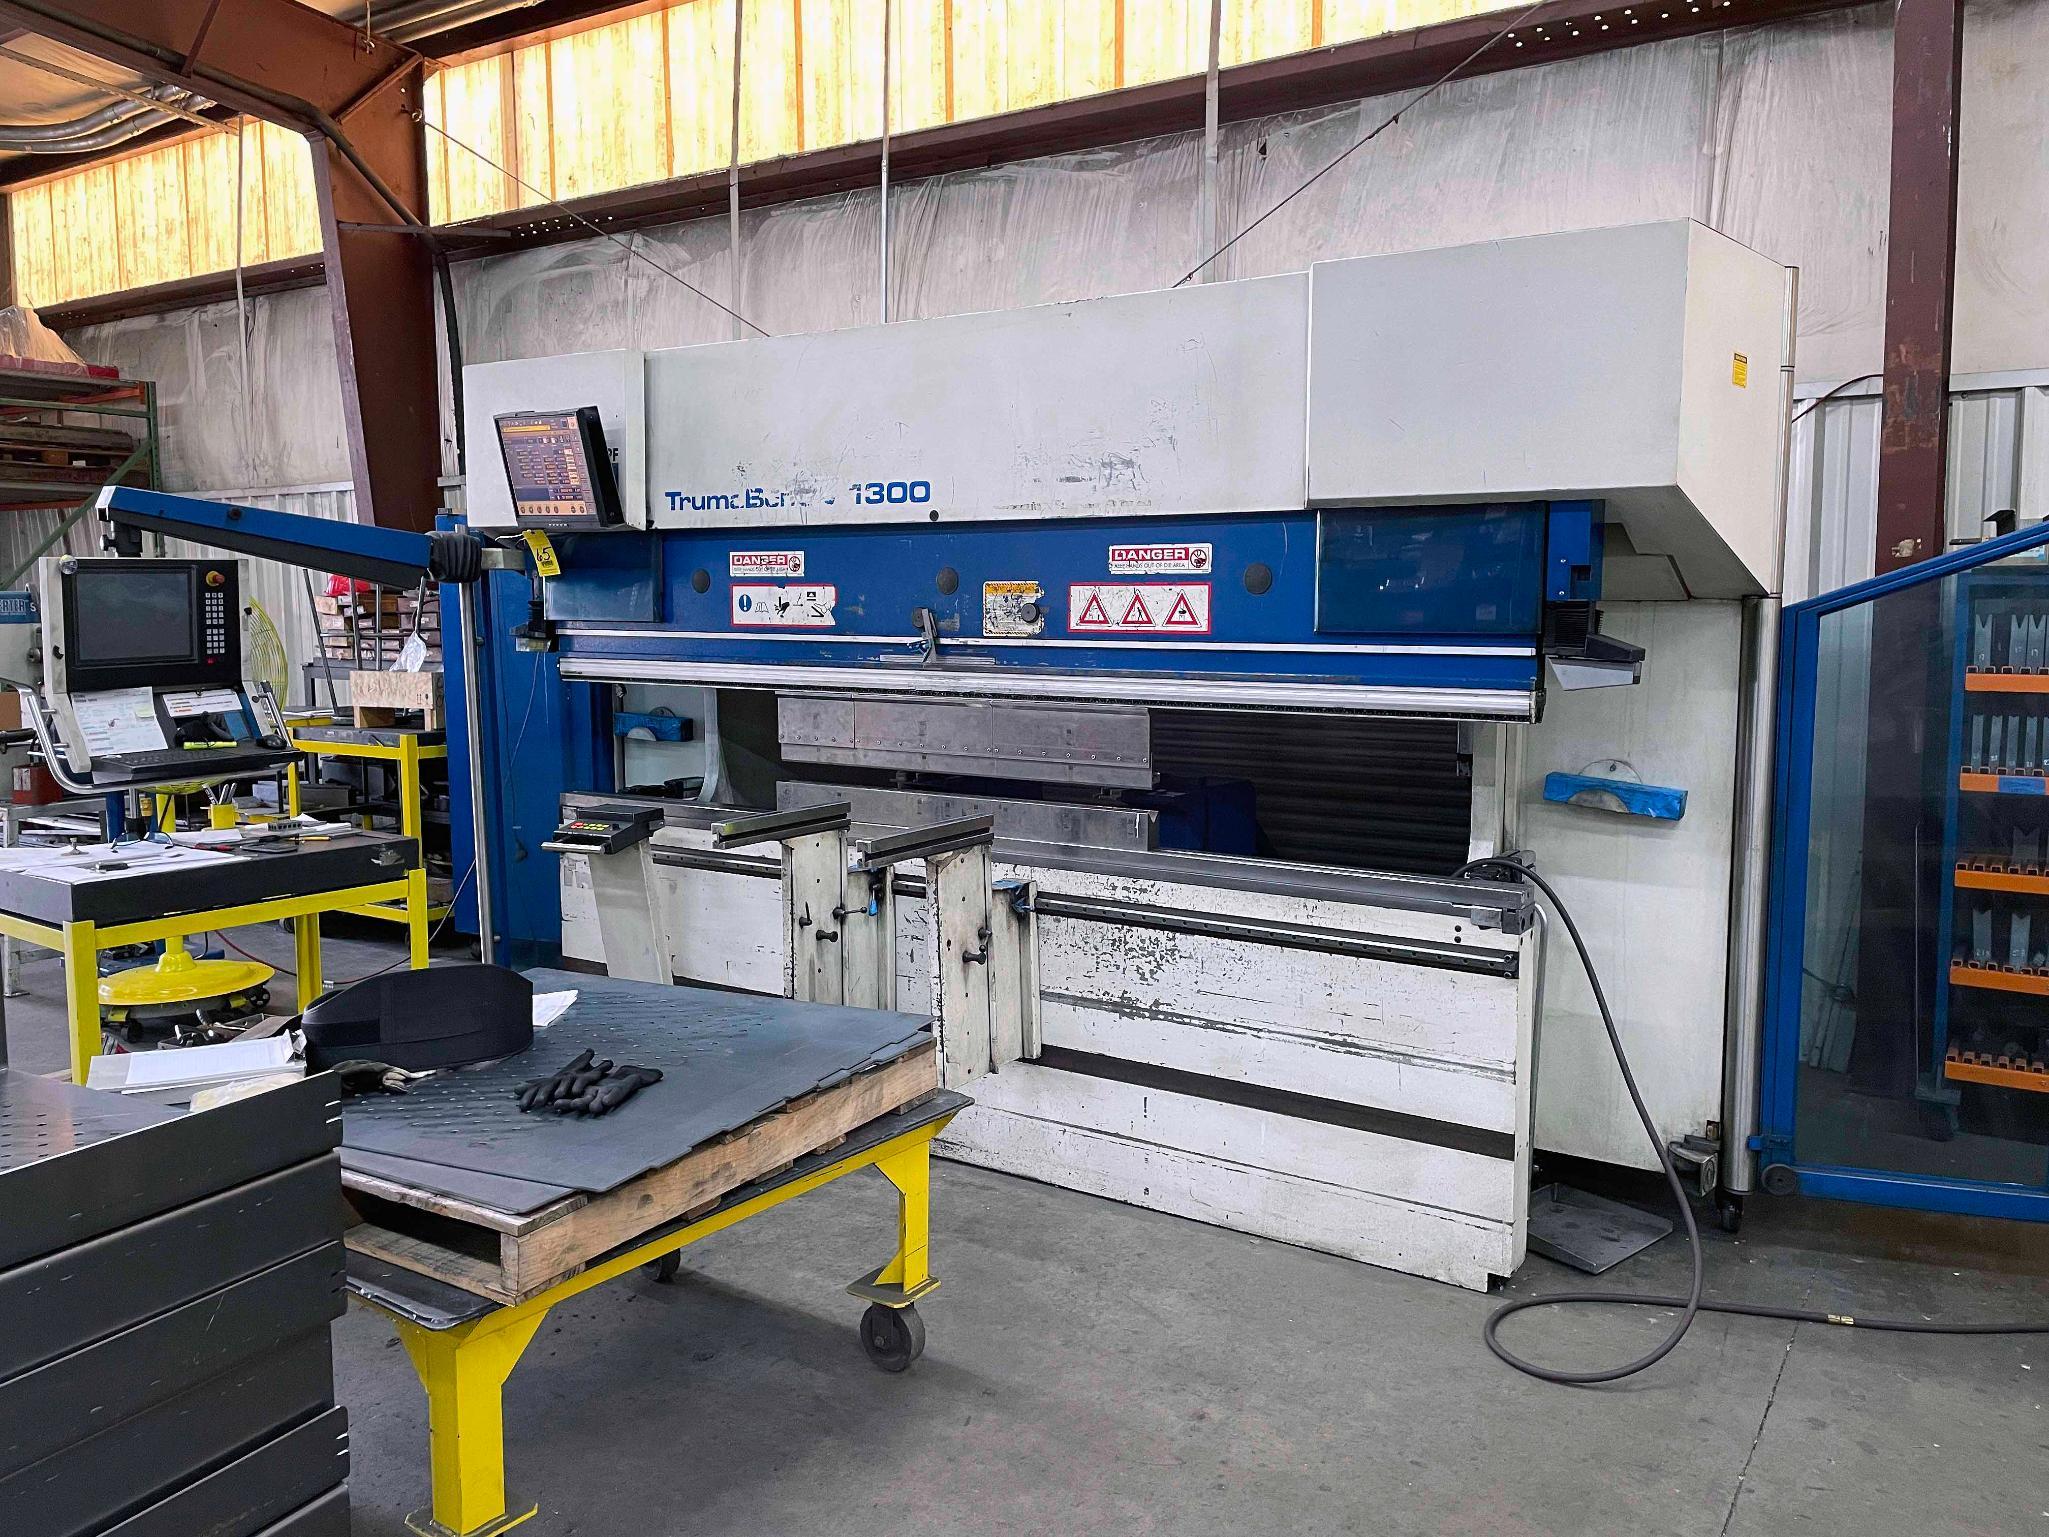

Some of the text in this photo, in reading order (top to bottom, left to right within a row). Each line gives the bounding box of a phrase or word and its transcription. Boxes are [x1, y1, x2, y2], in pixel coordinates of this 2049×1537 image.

[848, 480, 931, 505] 1300
[1114, 549, 1186, 560] DANGER
[734, 556, 785, 565] DANGER
